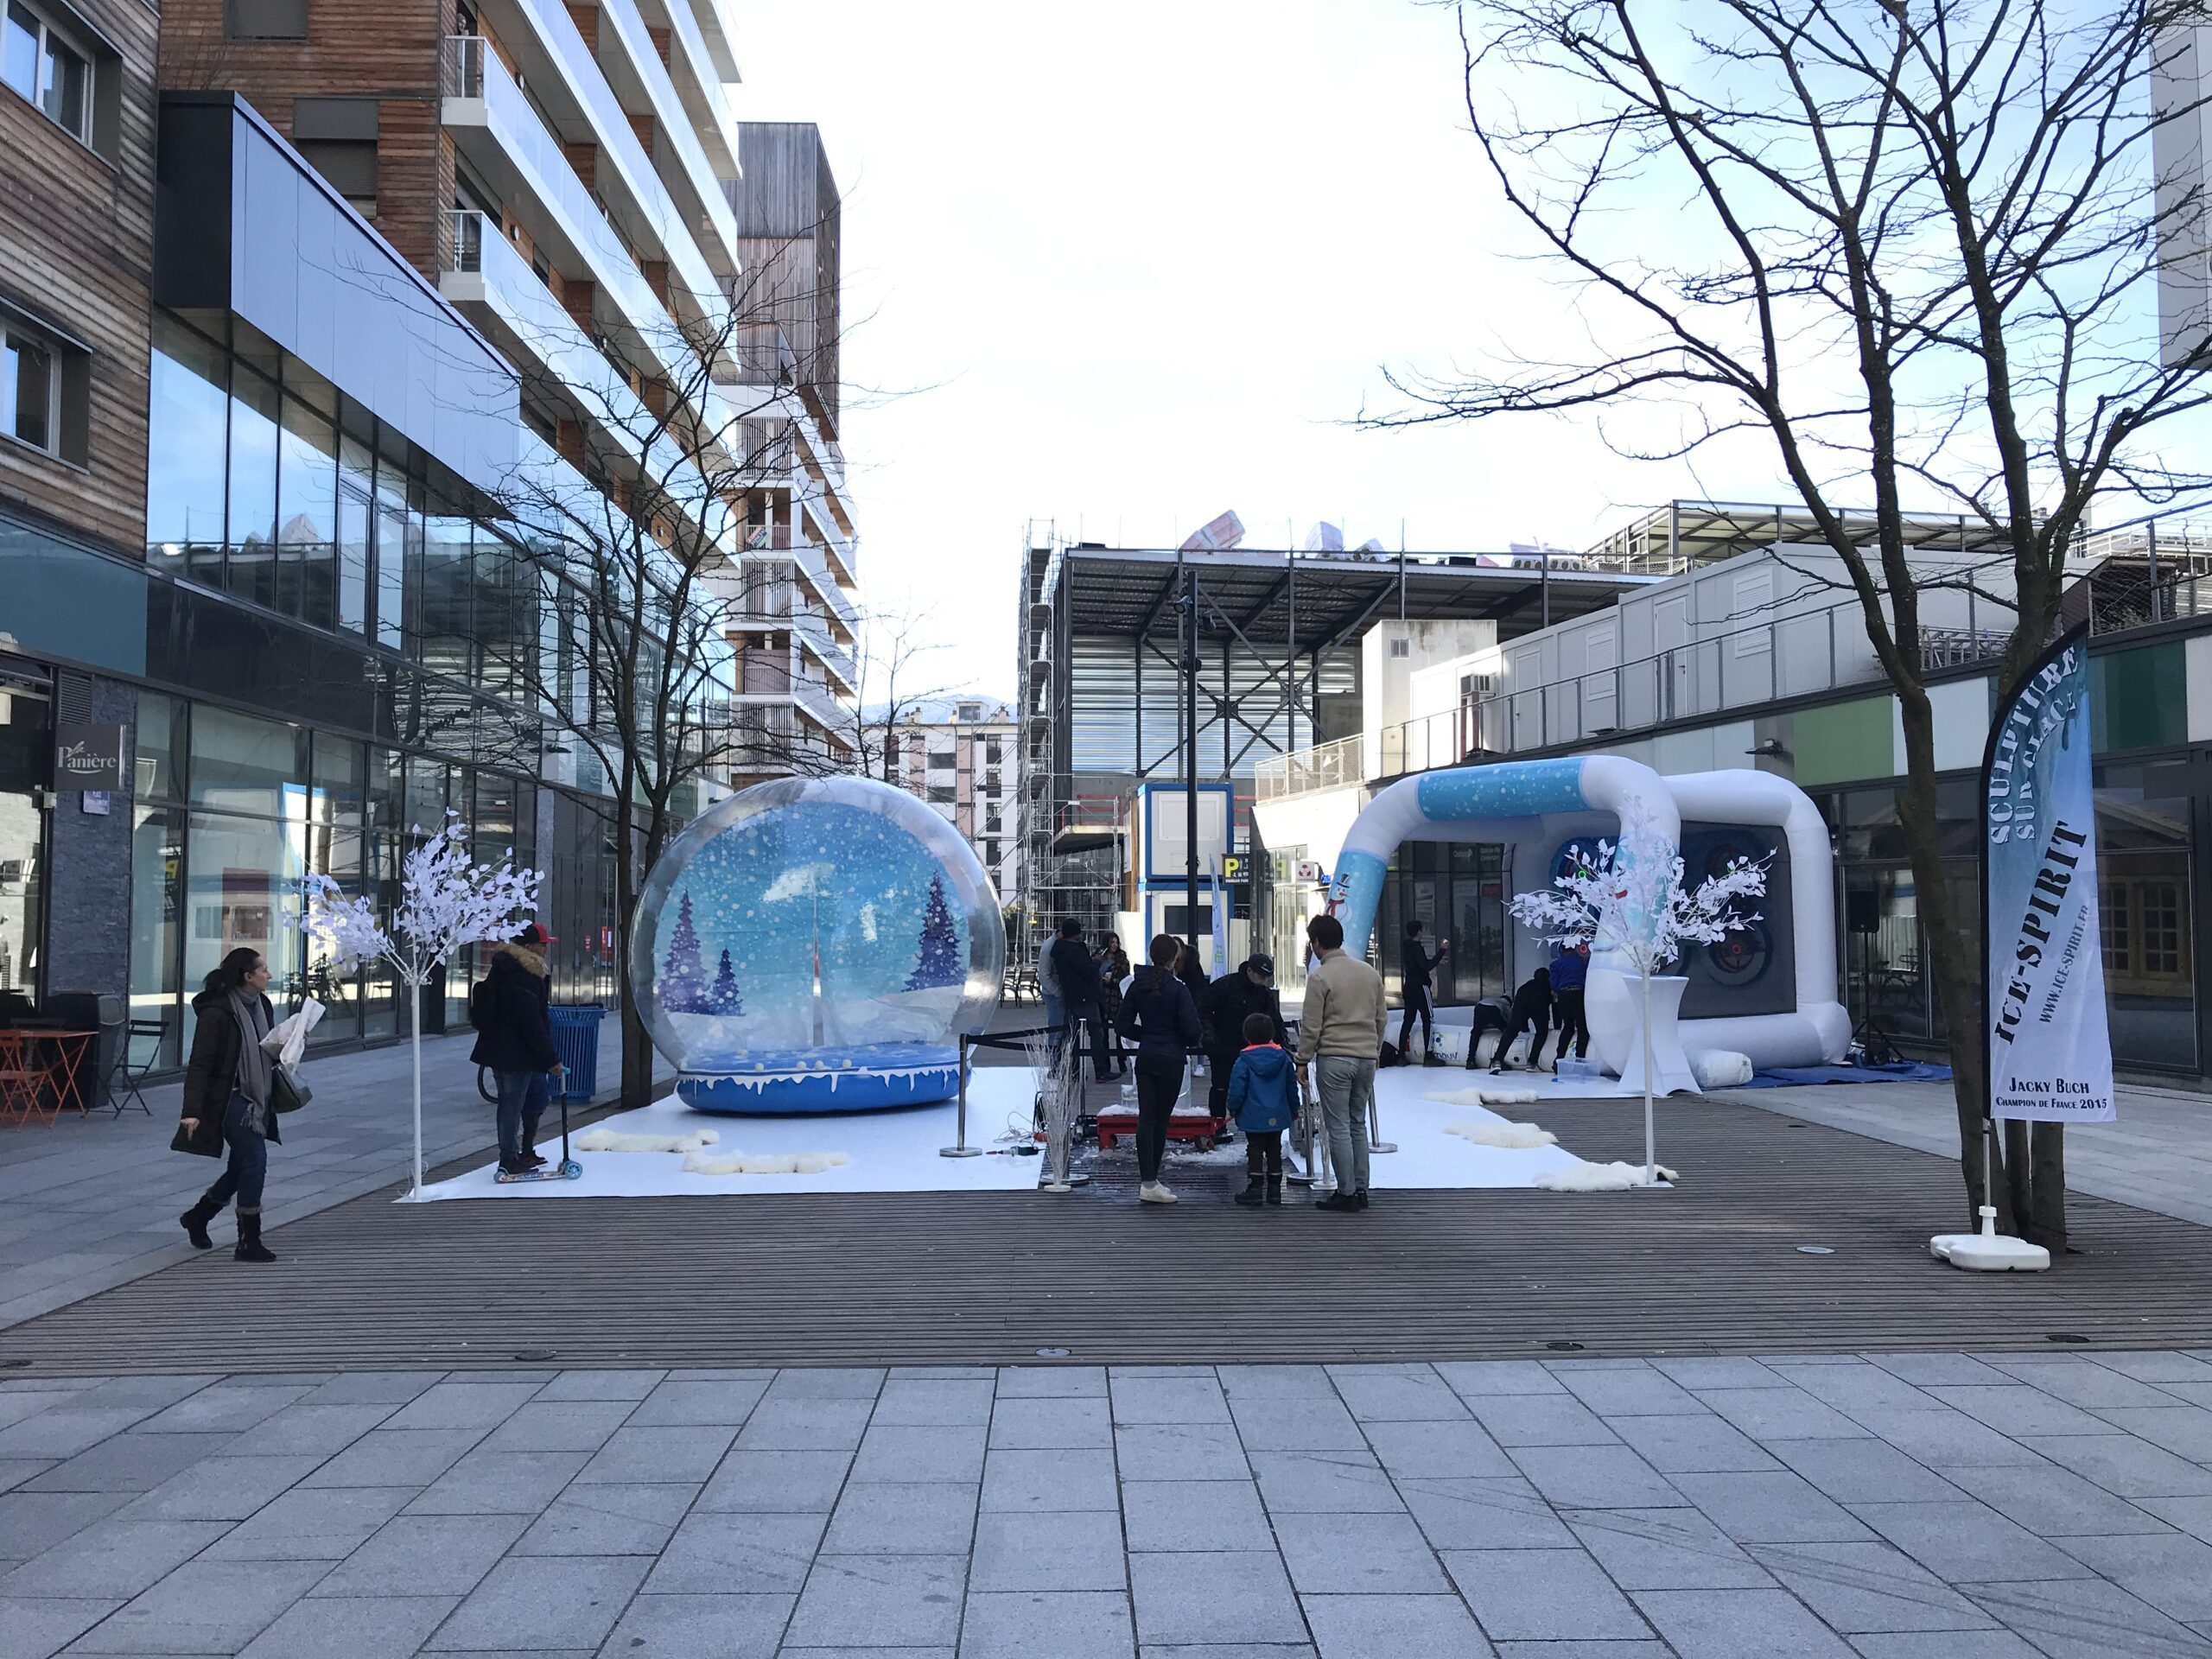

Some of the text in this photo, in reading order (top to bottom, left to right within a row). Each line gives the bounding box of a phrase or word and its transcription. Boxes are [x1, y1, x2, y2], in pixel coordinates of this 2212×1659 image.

[58, 747, 116, 768] Panière
[1989, 646, 2078, 843] SCULPTURE
[2015, 780, 2035, 840] SUR
[1225, 858, 1239, 878] P
[1994, 820, 2087, 1046] ICE-SPIRIT
[2039, 905, 2088, 1023] WWW.ICE-SPIRIT.FR
[1996, 1096, 2037, 1108] CHAMPION
[2051, 1098, 2077, 1109] FRANCE
[2080, 1098, 2107, 1109] 2015
[2009, 1077, 2089, 1093] JACKY BUCH
